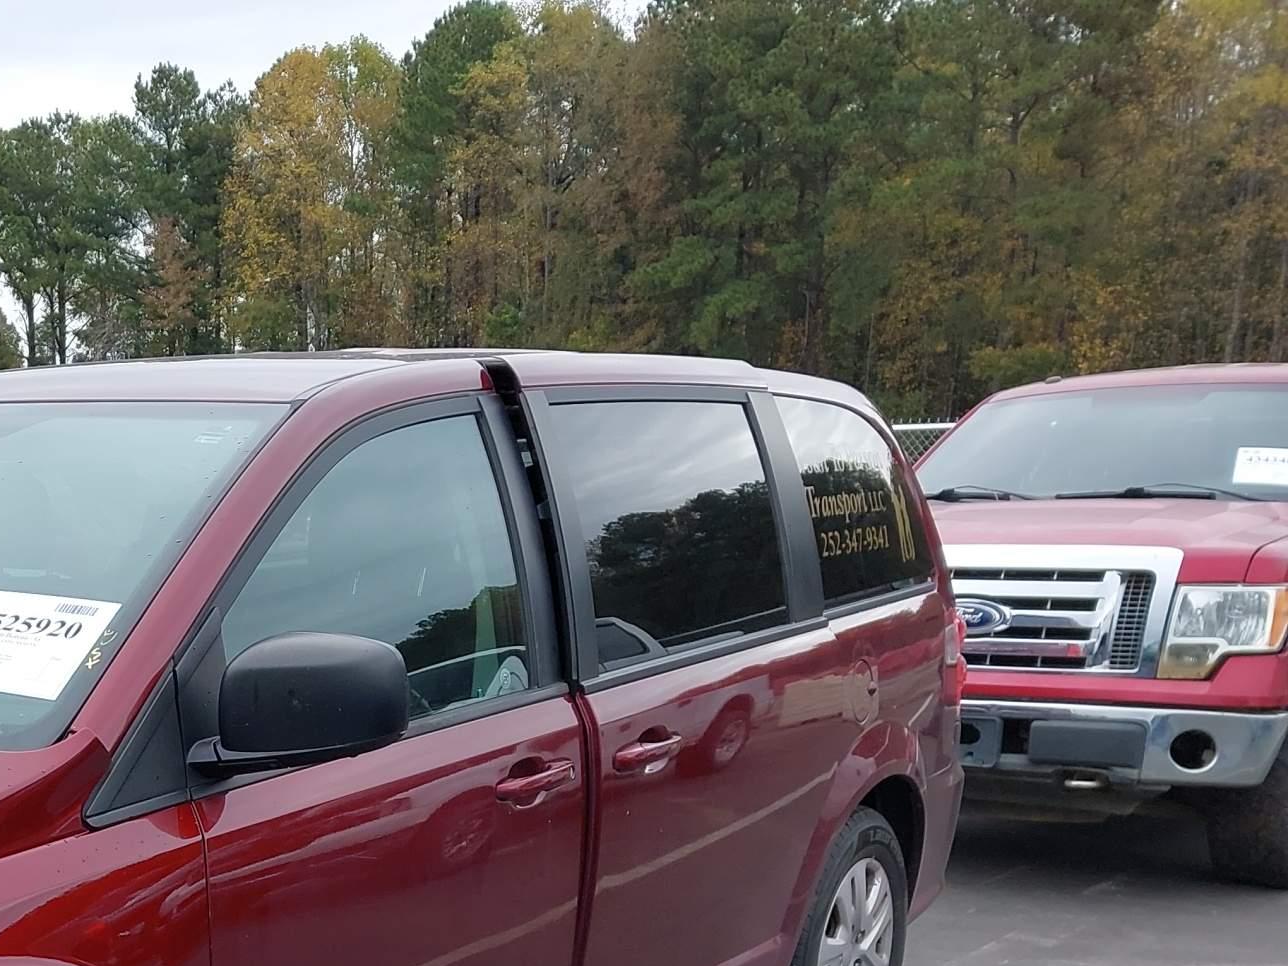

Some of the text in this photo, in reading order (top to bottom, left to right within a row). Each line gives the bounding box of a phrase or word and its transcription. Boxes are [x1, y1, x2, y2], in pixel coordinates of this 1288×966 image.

[805, 486, 887, 523] Transport LLC
[820, 524, 890, 557] 252-347-9341
